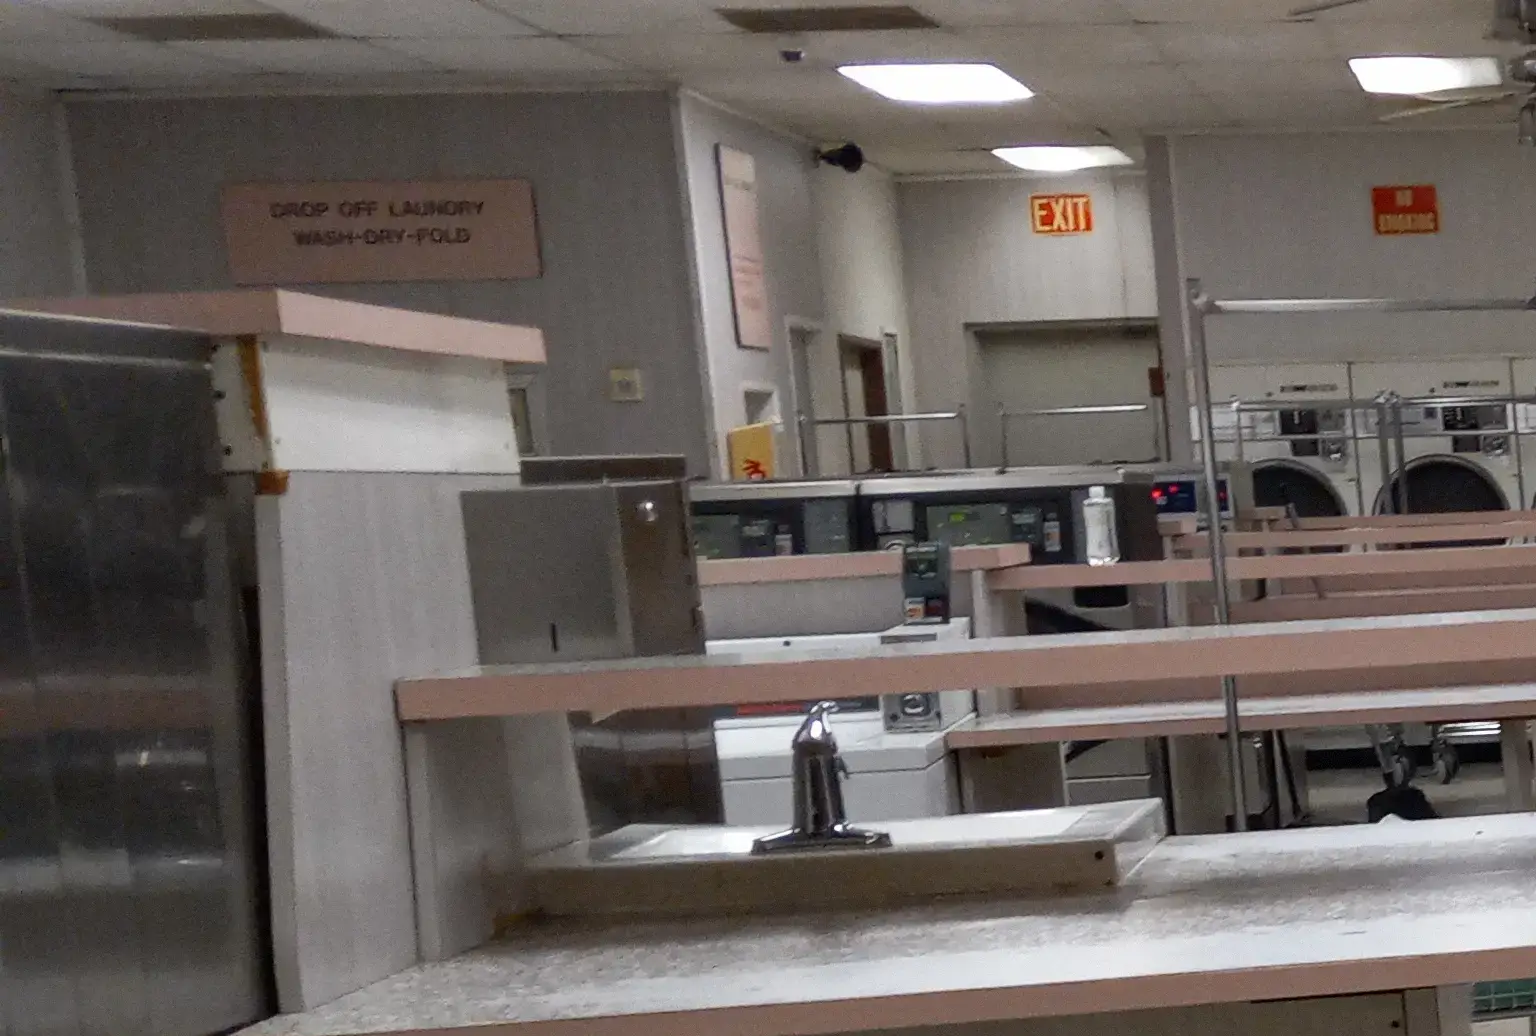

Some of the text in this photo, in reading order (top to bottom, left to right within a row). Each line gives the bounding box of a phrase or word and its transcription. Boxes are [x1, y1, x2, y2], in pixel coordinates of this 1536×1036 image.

[269, 201, 484, 218] DROP OFF LAUNDRY
[1034, 198, 1088, 230] EXIT
